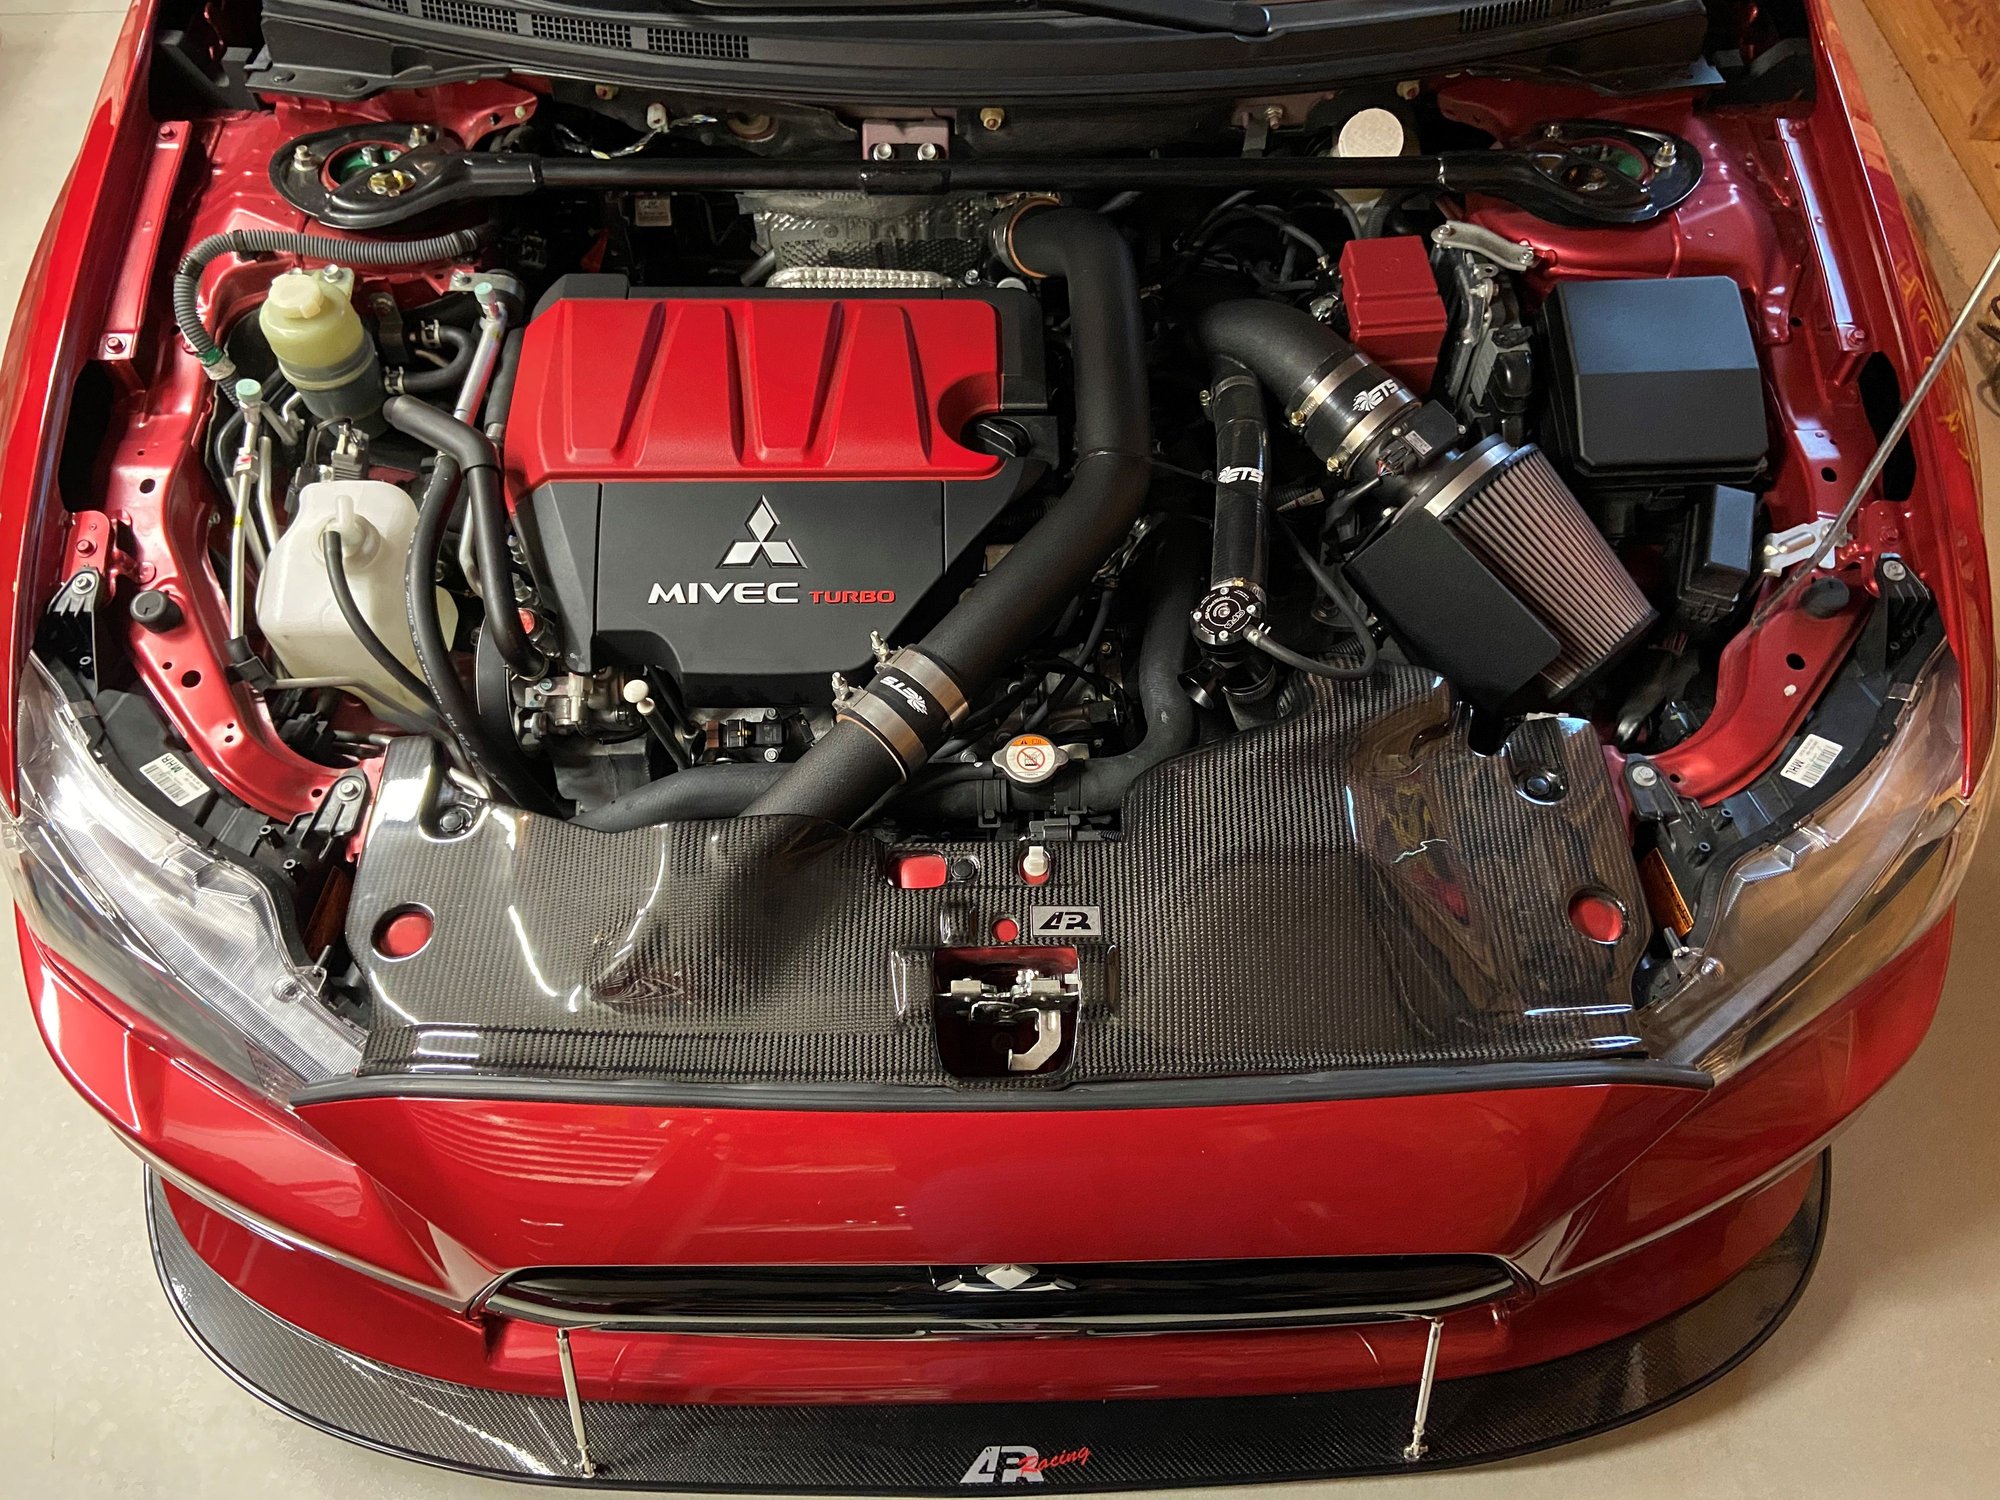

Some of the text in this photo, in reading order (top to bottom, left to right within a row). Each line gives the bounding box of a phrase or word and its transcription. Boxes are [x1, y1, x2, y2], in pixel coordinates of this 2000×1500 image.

[1361, 379, 1399, 407] ETS
[1226, 466, 1264, 483] ETS
[648, 582, 896, 604] MIVEC TURBO
[880, 676, 922, 703] ETS
[161, 755, 184, 774] MHR
[1784, 758, 1805, 775] MHL
[1018, 1446, 1091, 1477] Racing
